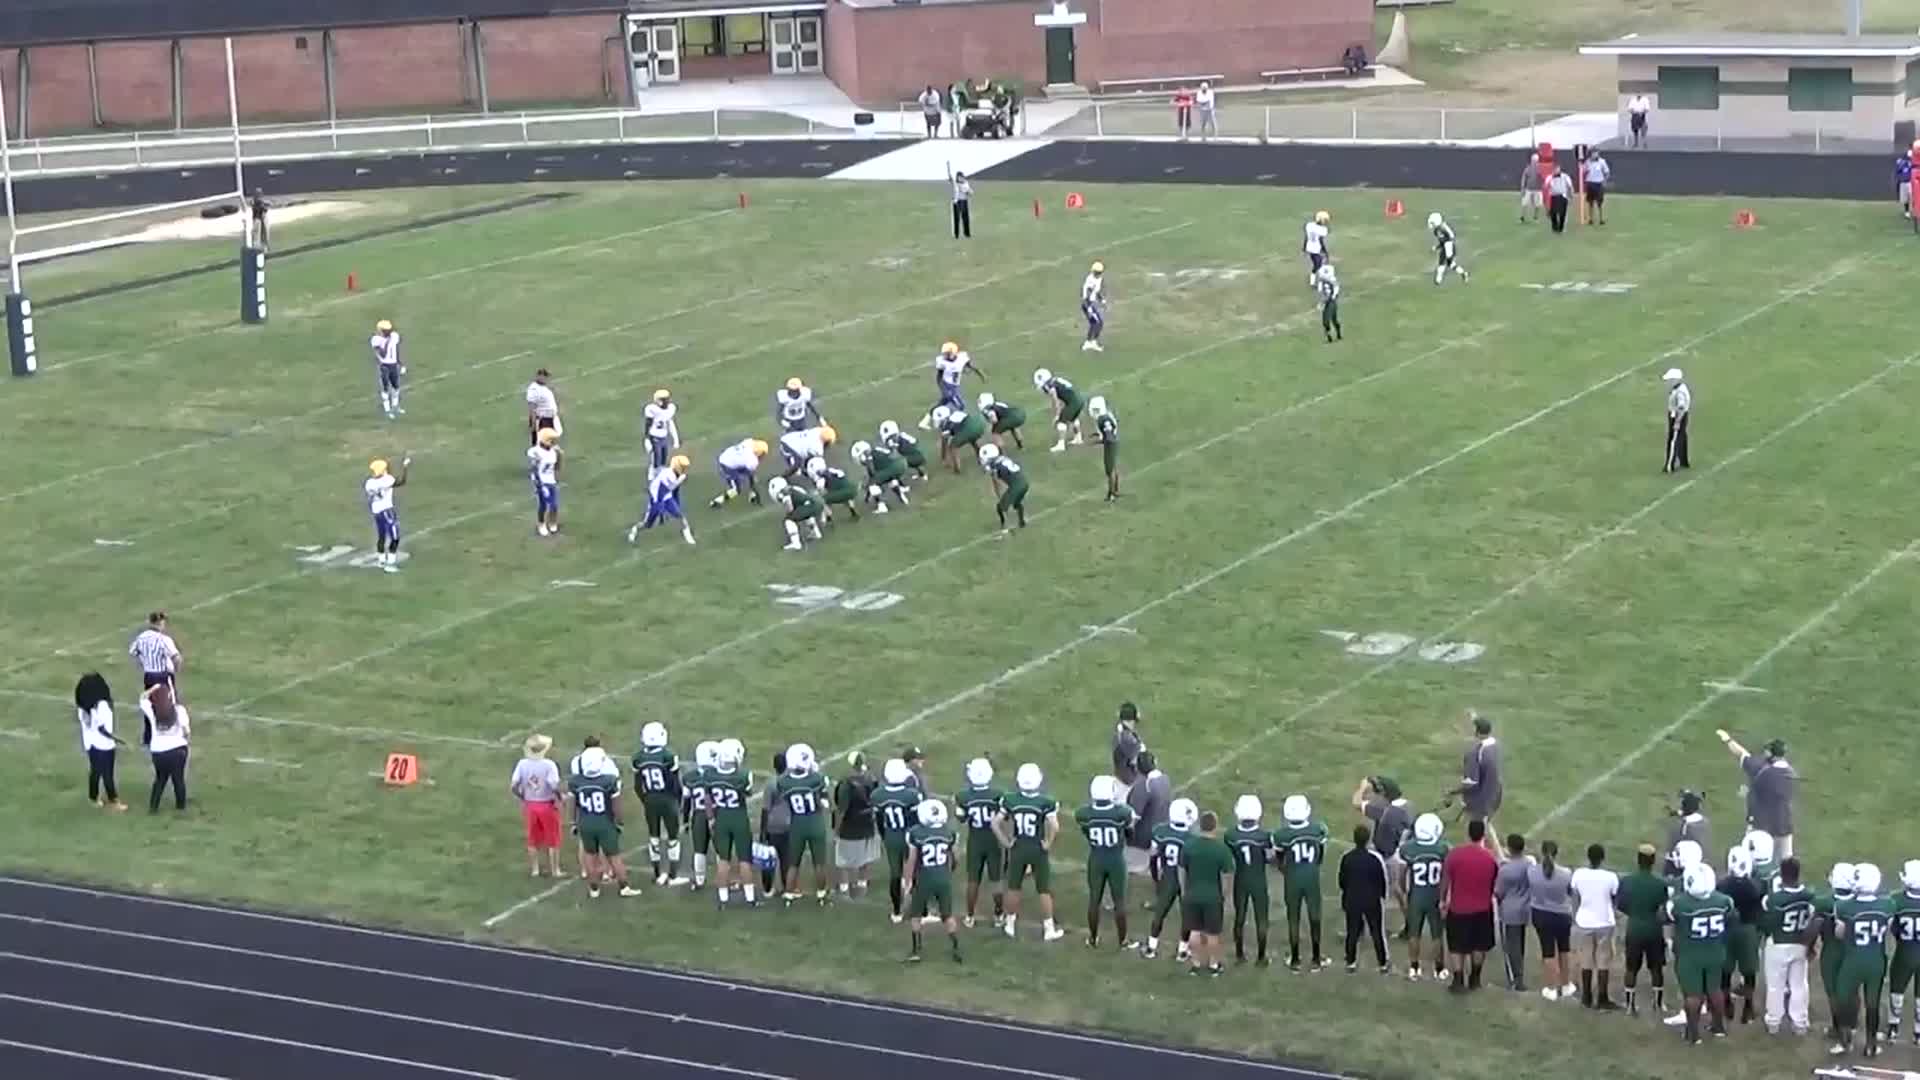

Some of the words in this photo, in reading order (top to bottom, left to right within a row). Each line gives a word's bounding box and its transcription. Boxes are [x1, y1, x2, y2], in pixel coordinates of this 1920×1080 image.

[389, 757, 409, 781] 20
[641, 767, 666, 791] 19
[578, 791, 606, 814] 48
[790, 792, 816, 814] 81
[884, 805, 905, 829] 11
[967, 806, 995, 829] 34
[1014, 812, 1037, 838] 16
[1089, 826, 1119, 848] 90
[921, 842, 949, 867] 26
[1164, 844, 1179, 867] 9
[1240, 844, 1252, 865] 1
[1291, 842, 1316, 864] 14
[1412, 861, 1442, 886] 20
[1690, 914, 1725, 939] 55
[1854, 919, 1888, 946] 54
